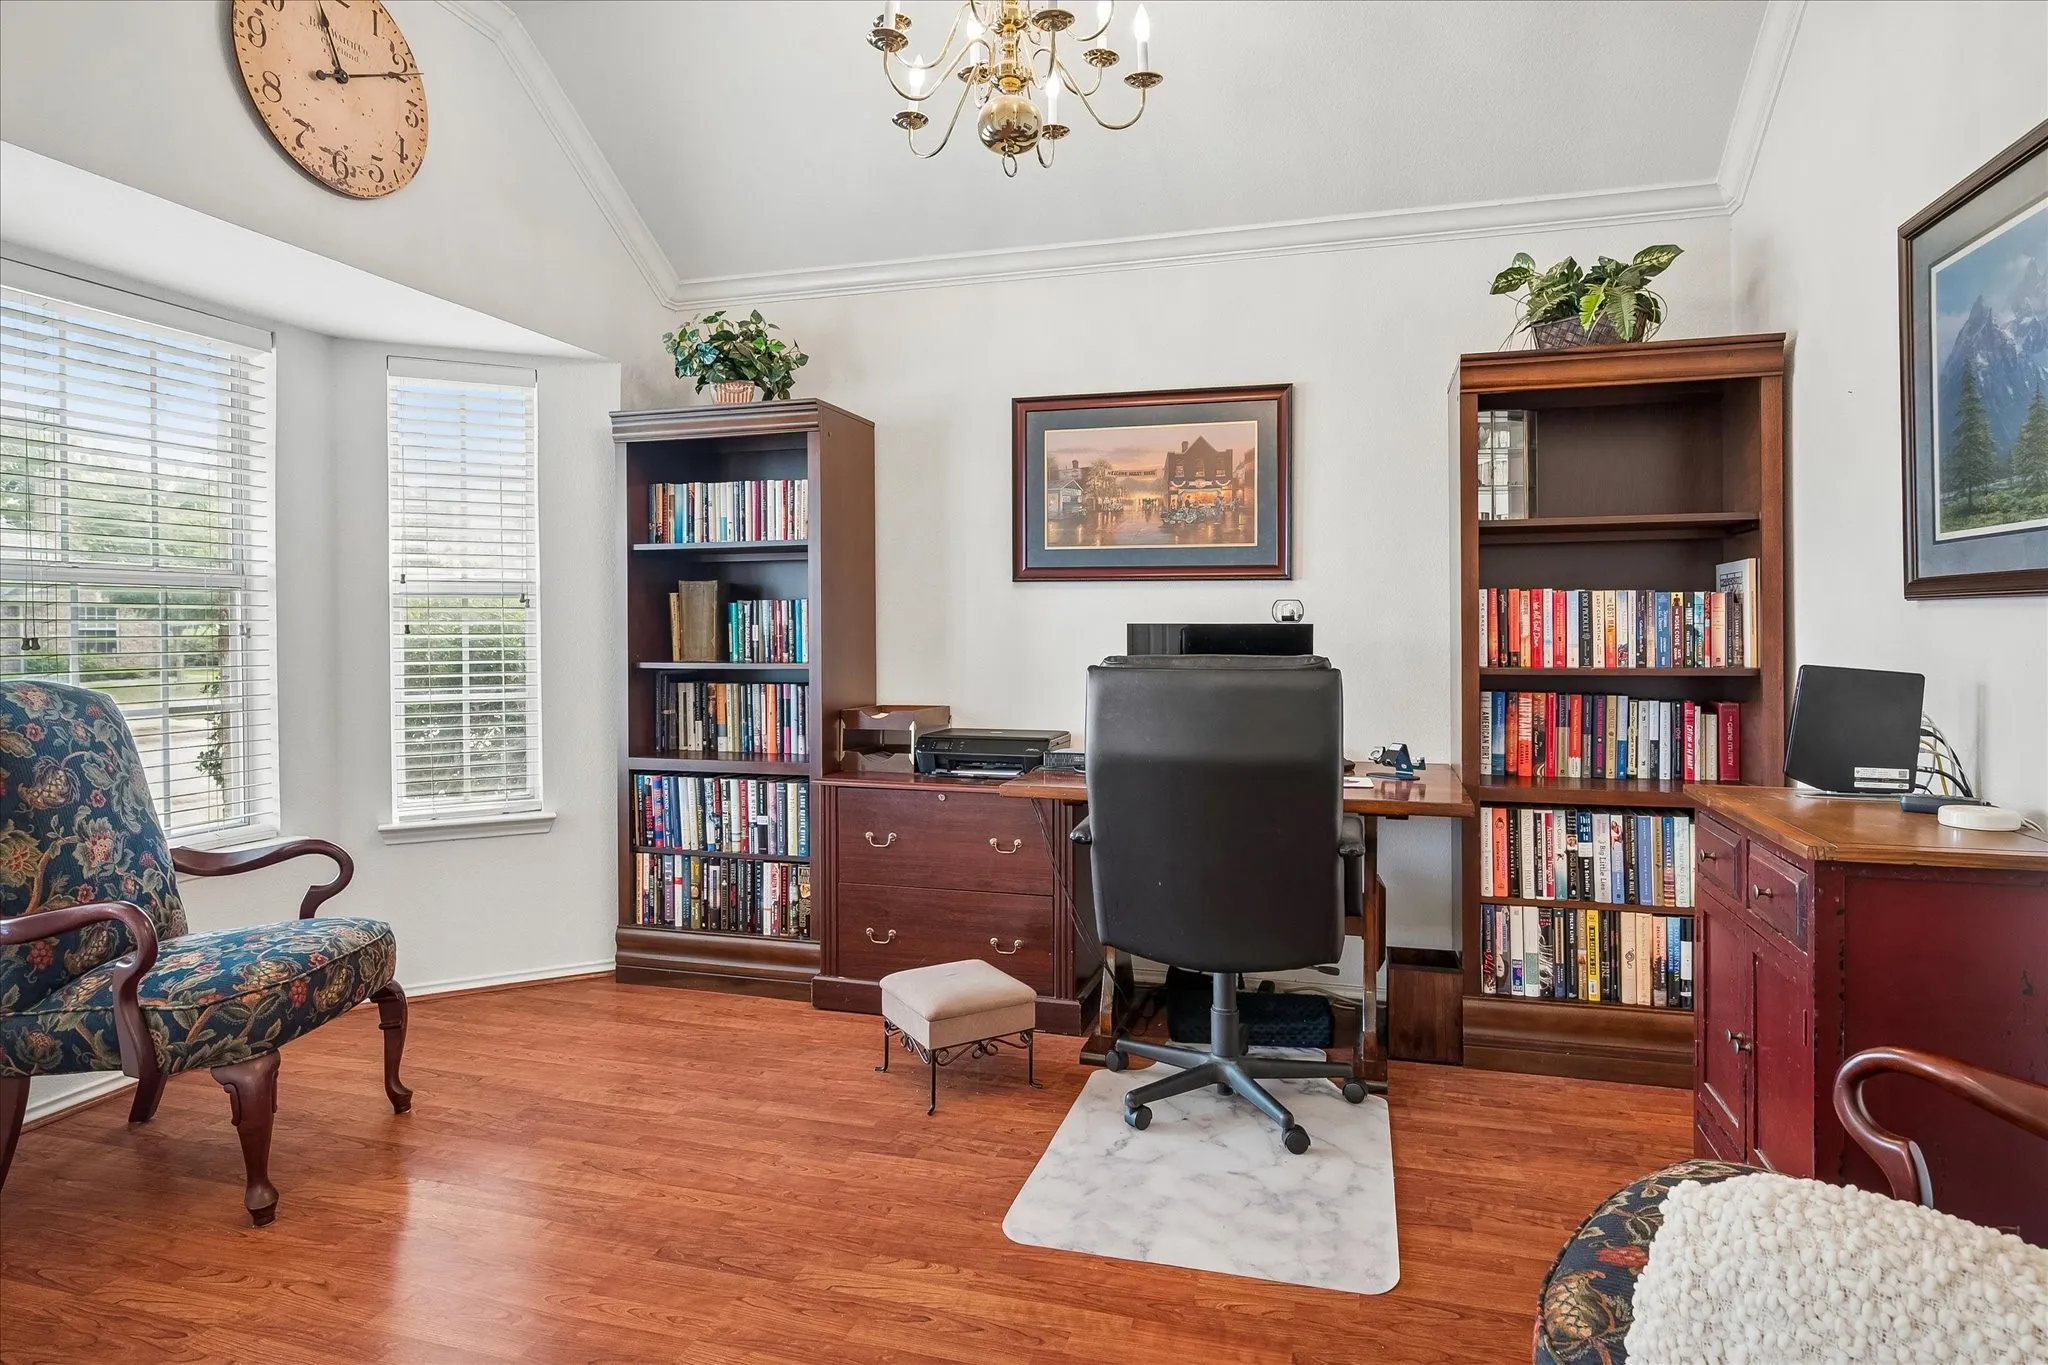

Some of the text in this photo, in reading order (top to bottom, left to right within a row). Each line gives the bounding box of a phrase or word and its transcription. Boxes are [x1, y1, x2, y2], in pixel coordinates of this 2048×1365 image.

[247, 15, 267, 48] 9
[392, 52, 408, 84] 2
[262, 70, 282, 103] 8
[405, 100, 419, 128] 3
[294, 116, 312, 149] 7
[392, 134, 408, 164] 4
[332, 150, 349, 180] 6
[369, 154, 384, 183] 5
[1519, 698, 1532, 741] AIRFRAME
[1484, 952, 1495, 974] 1776
